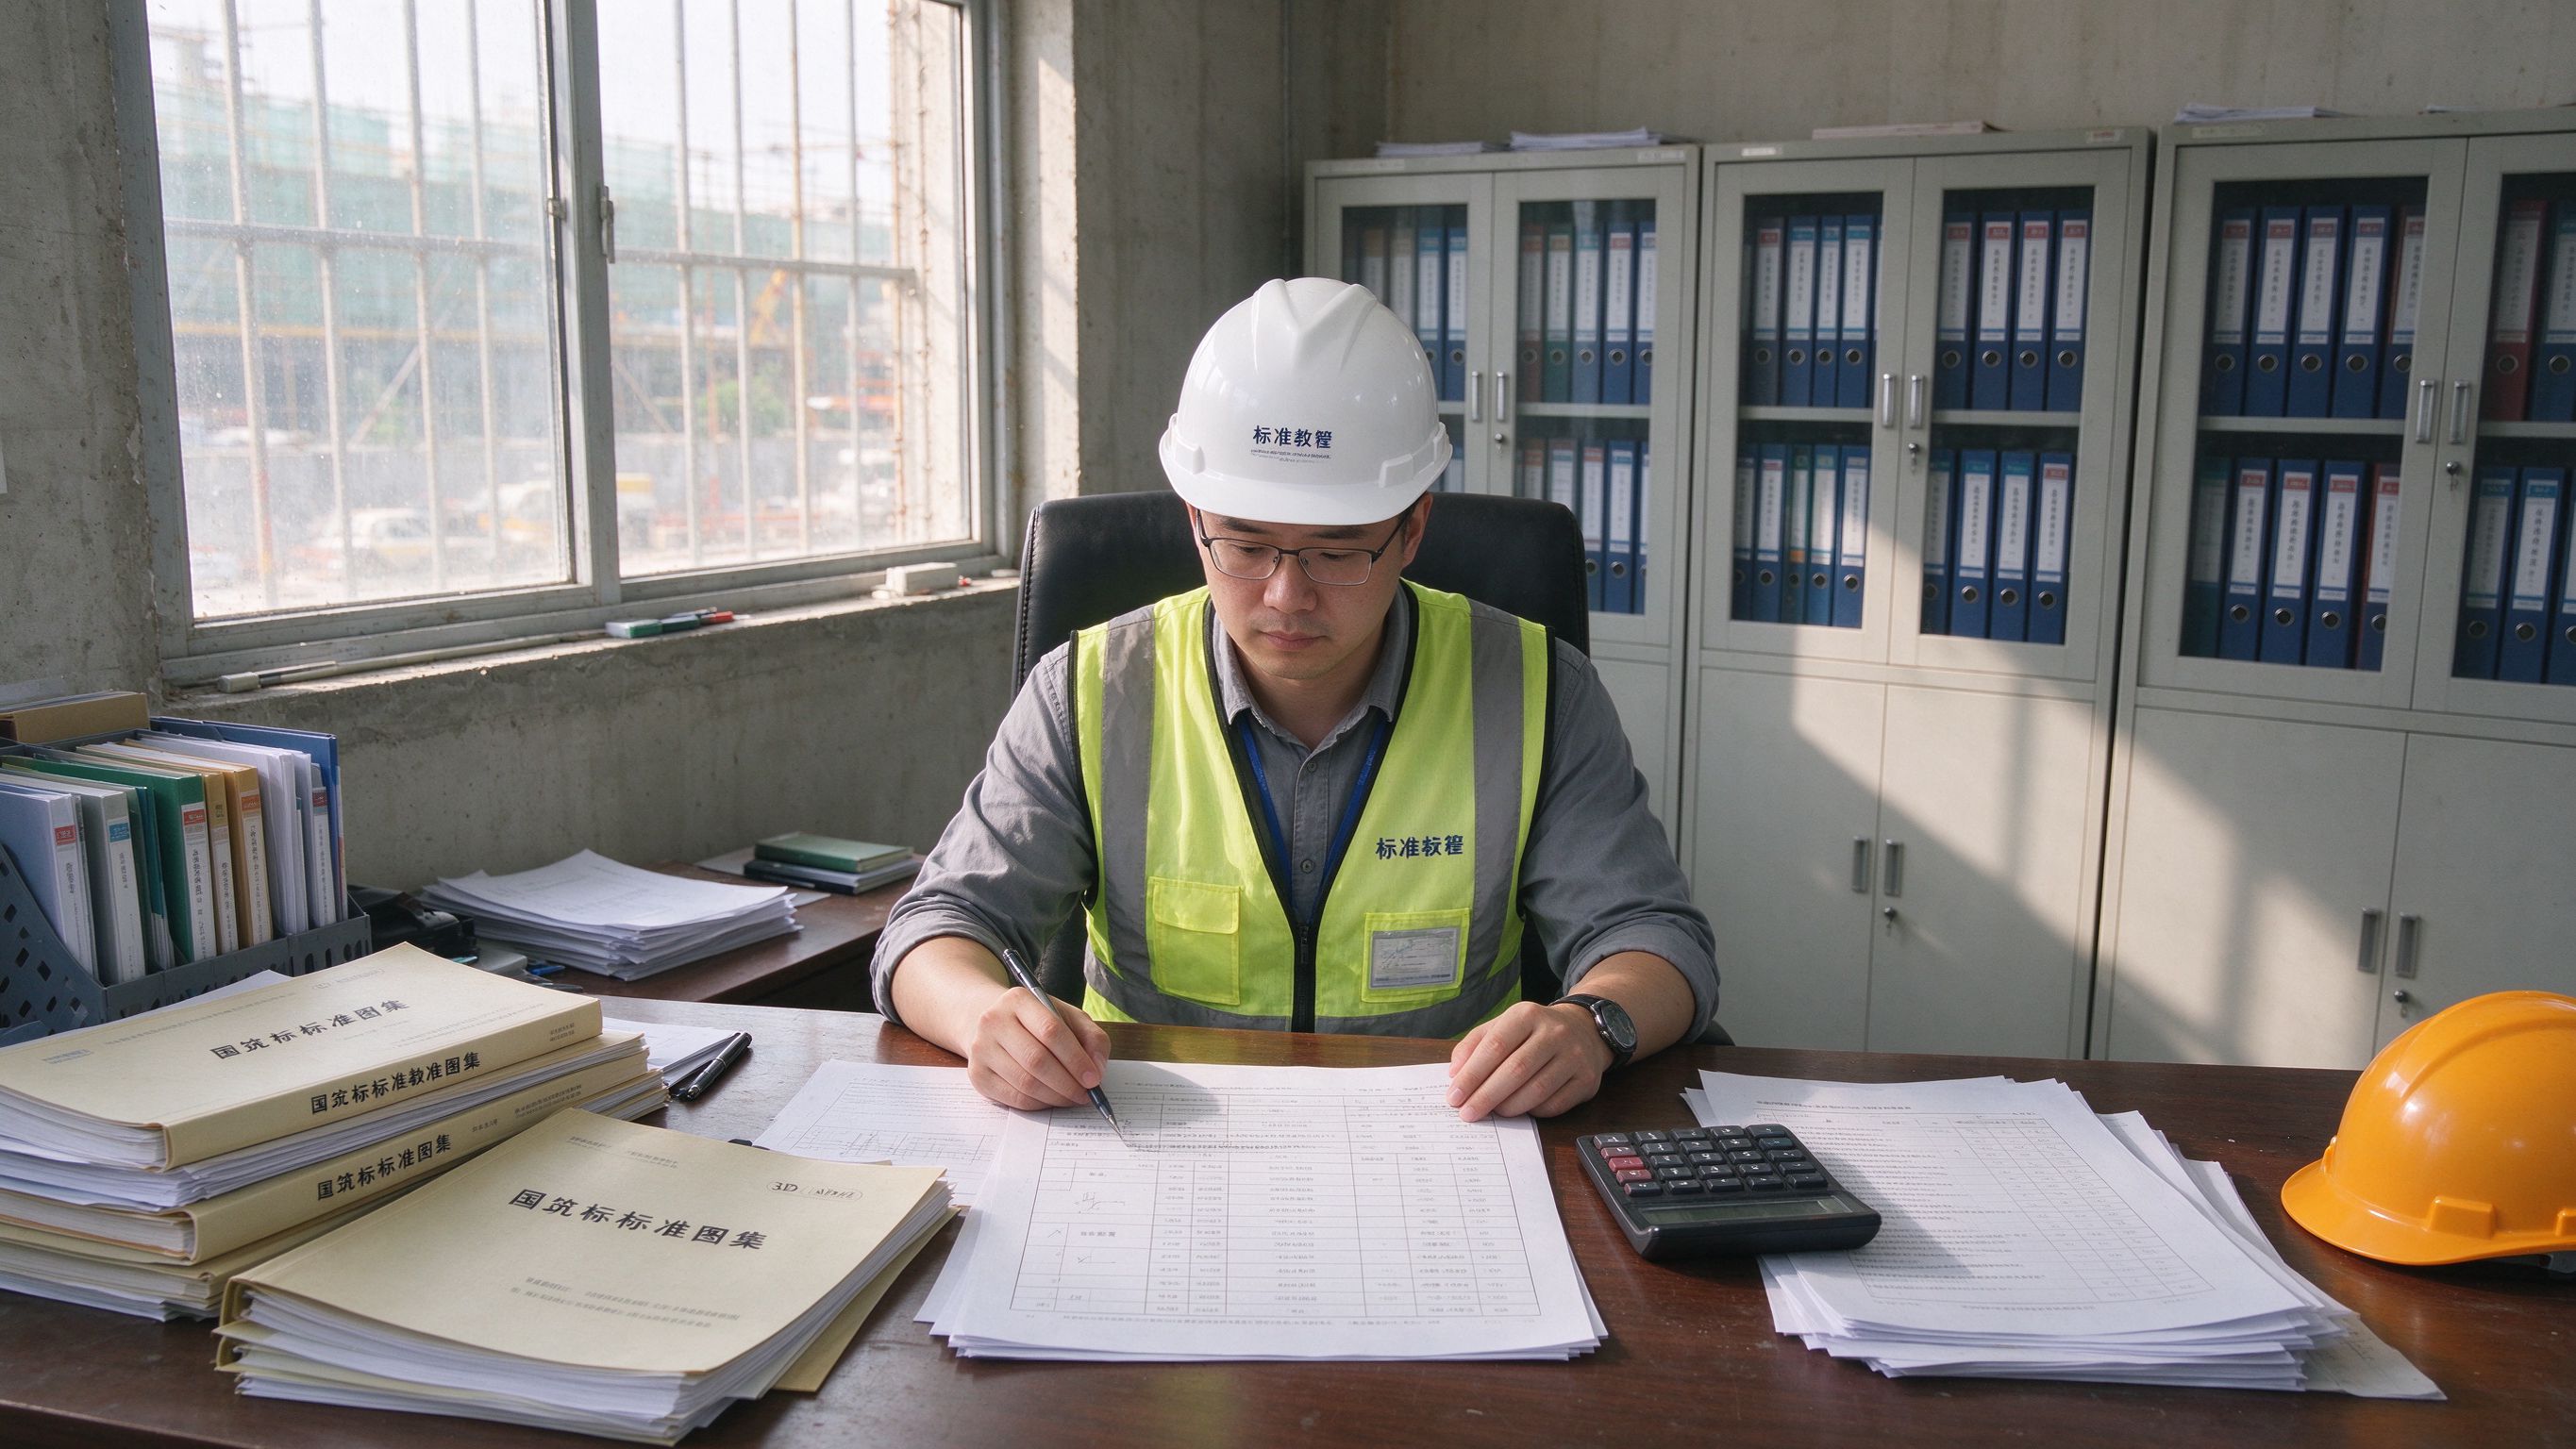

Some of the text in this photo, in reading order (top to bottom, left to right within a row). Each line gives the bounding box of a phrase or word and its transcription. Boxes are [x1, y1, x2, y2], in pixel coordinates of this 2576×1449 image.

[508, 1189, 768, 1250] 国筑标标准图集
